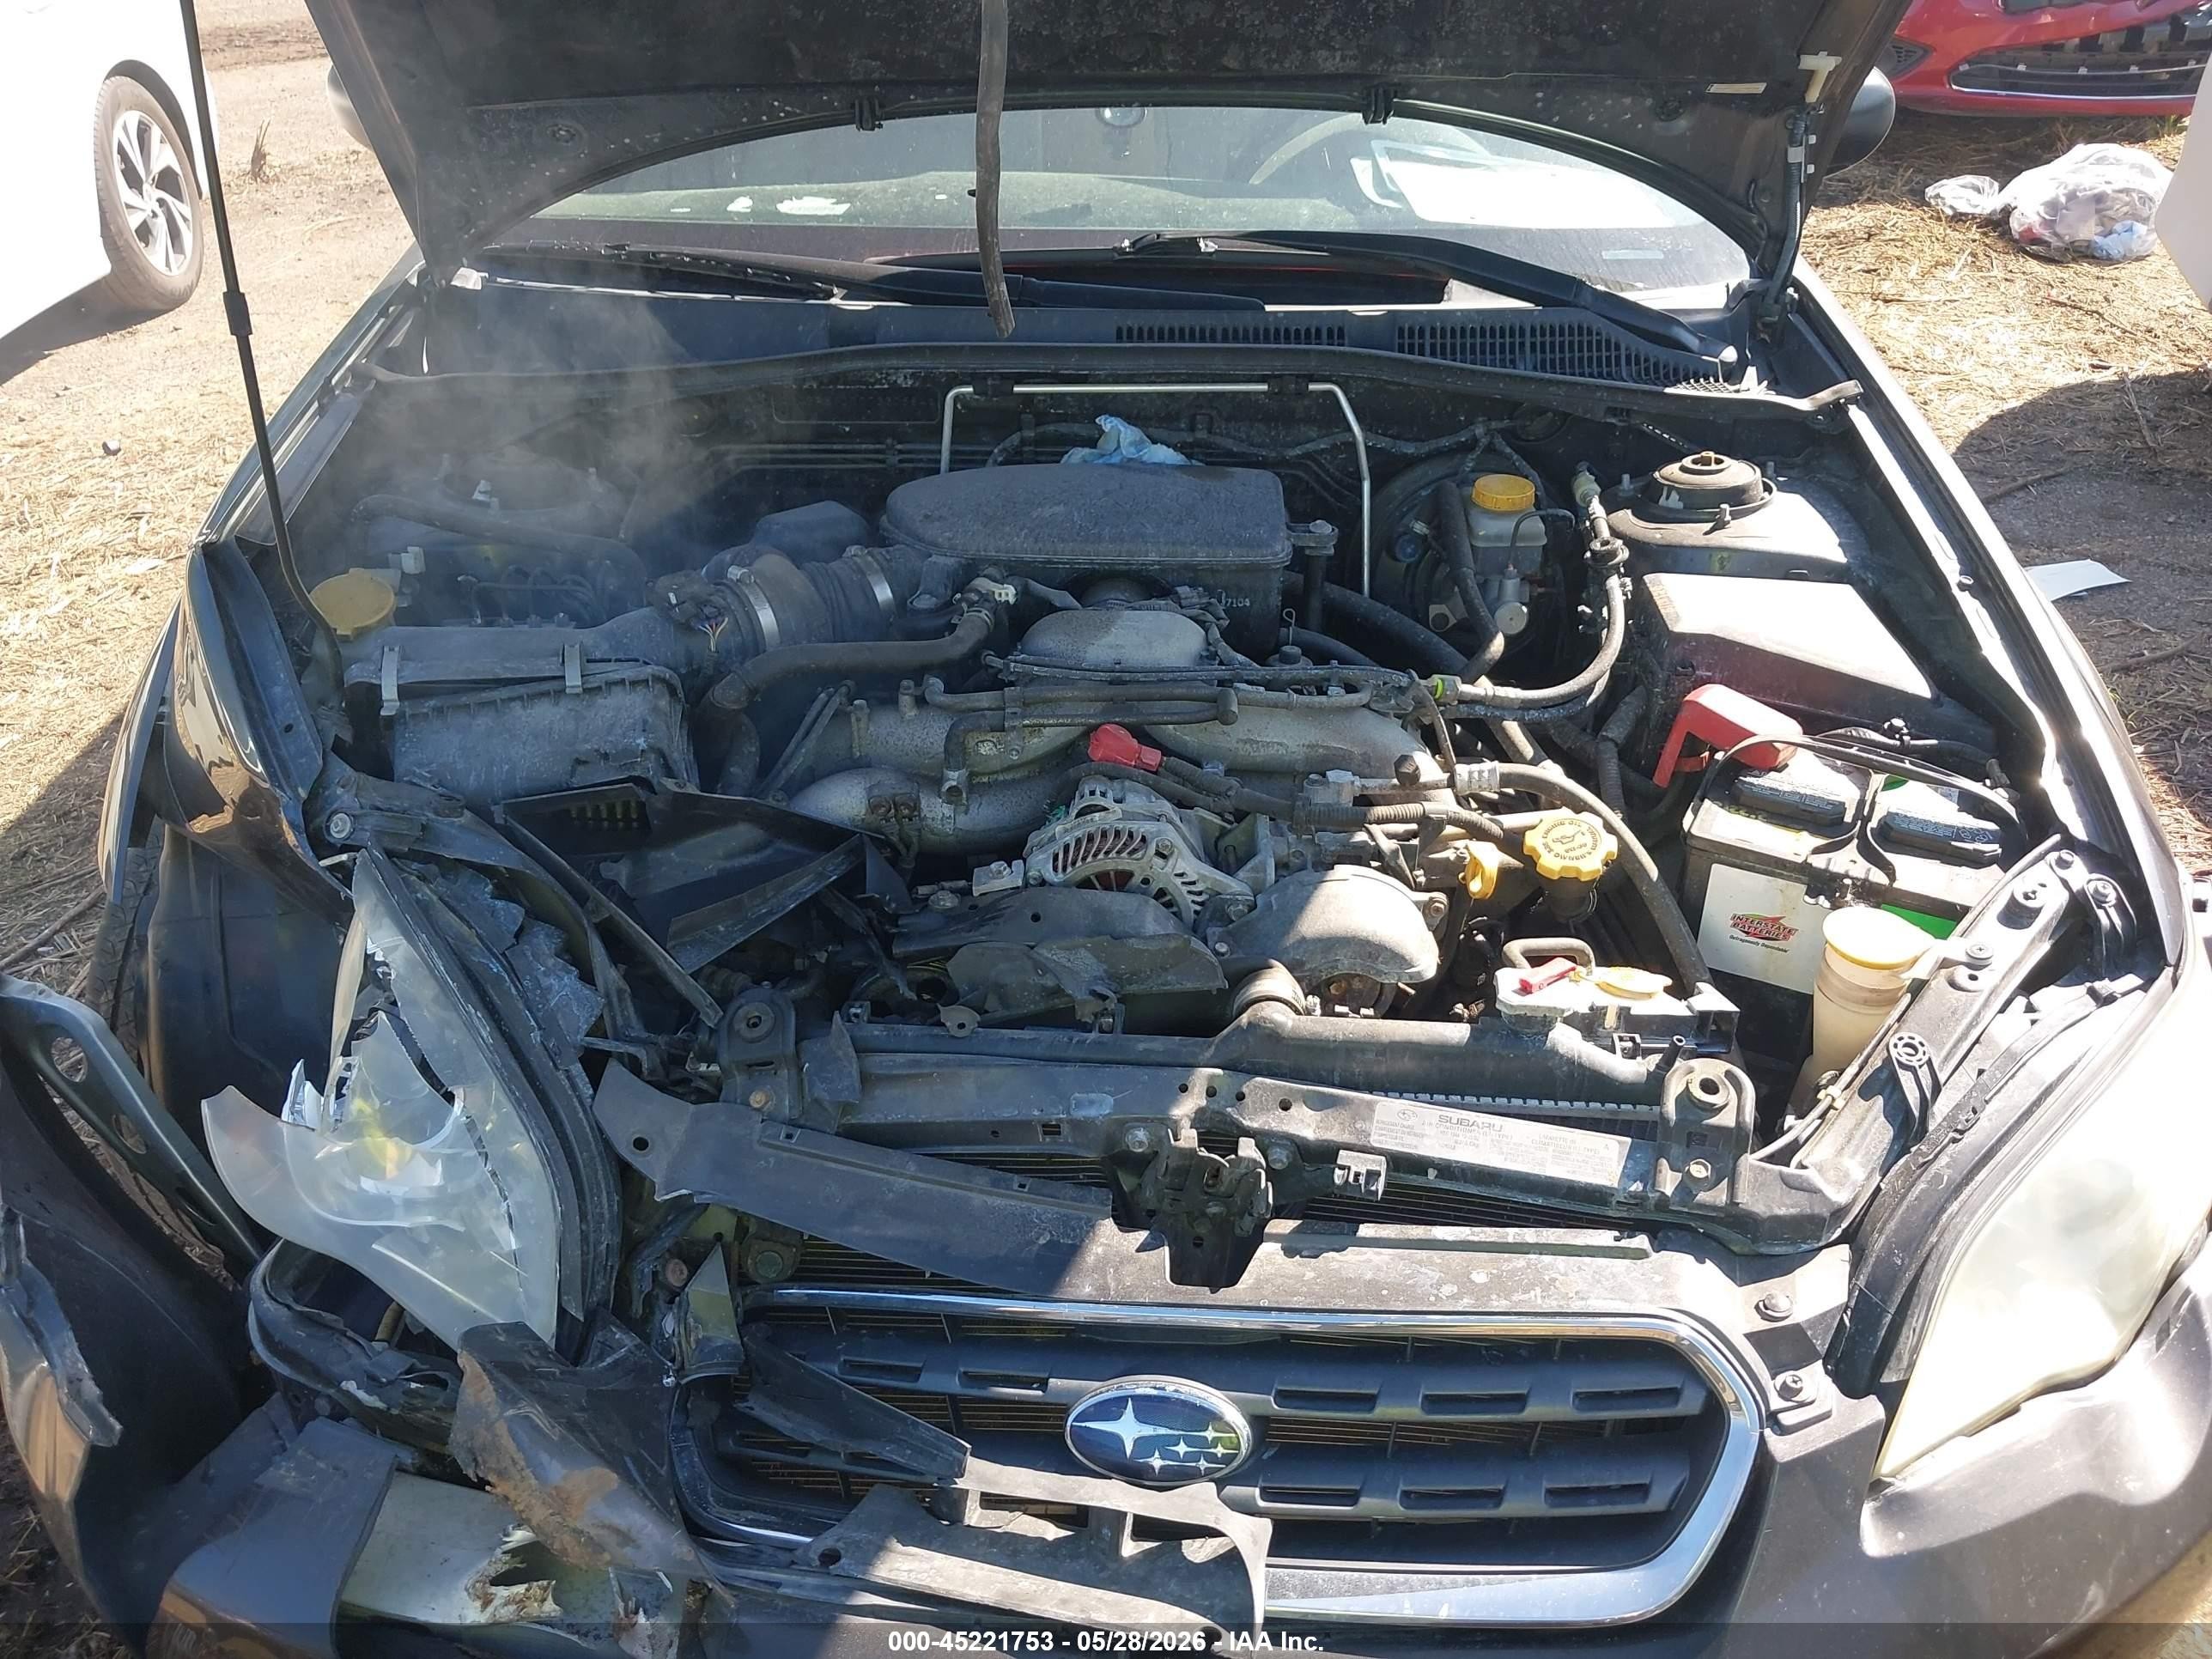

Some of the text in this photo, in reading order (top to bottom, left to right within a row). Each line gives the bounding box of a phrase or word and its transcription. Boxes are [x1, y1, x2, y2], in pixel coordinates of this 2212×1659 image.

[1730, 914, 1796, 936] INTERSTATE
[1731, 922, 1791, 941] BATTERIES
[1437, 1114, 1504, 1133] SUBARU
